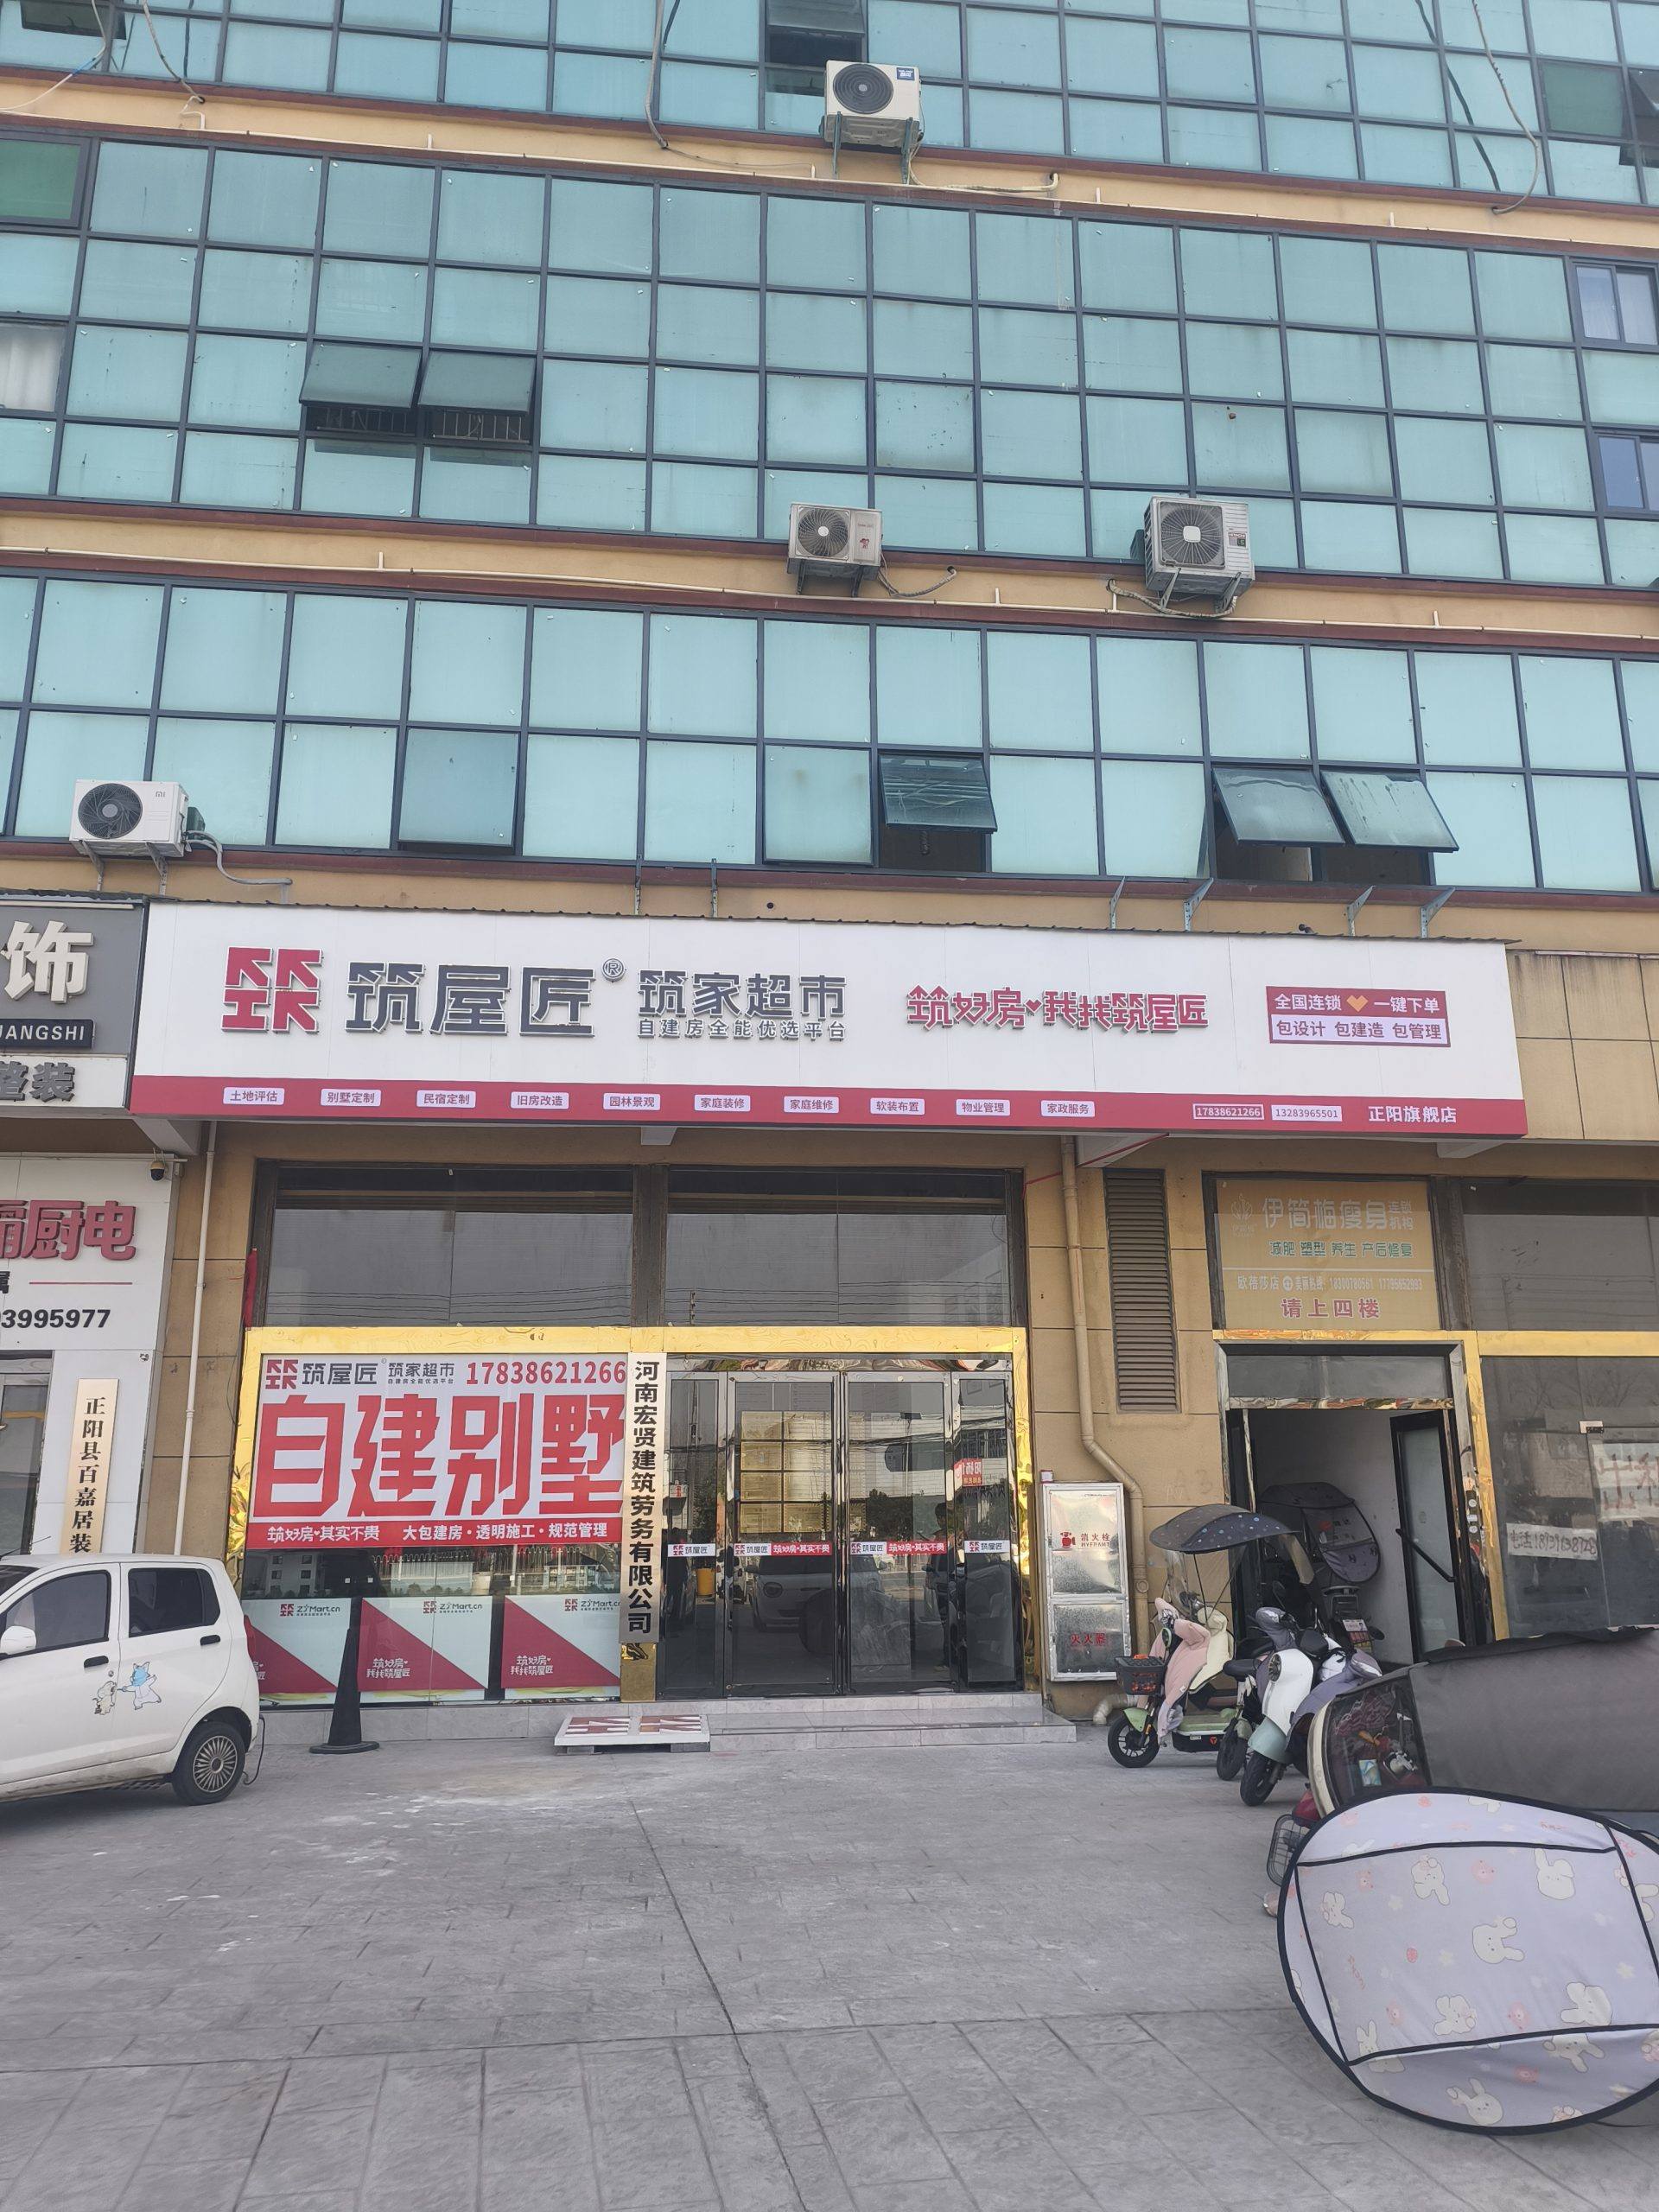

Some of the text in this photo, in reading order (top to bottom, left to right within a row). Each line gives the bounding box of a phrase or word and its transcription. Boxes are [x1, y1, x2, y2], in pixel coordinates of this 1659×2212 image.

[1, 920, 93, 1003] 饰
[346, 962, 594, 1036] 筑屋匠
[639, 970, 847, 1020] 筑家超市
[1274, 994, 1440, 1014] 全国连锁 一键下单
[0, 1025, 85, 1040] ANGSHI
[638, 1018, 847, 1040] 自建房全能优选平台
[1276, 1020, 1441, 1039] 包设计 包建造 包管理
[230, 1090, 1457, 1124] 土地评估 别墅定制 民宿定制 旧房改造 园林景观 家庭装修 家庭维修 软装布置 物业管理 家政服务 17838621266 13283965501 正阳旗舰店
[1269, 1241, 1413, 1258] 减肥 塑型 养生 产后修复
[0, 1308, 111, 1329] 3995977
[1281, 1297, 1380, 1319] 请上四楼
[302, 1363, 378, 1385] 筑屋匠
[388, 1363, 454, 1377] 筑家超市
[467, 1361, 626, 1385] 17838621266
[252, 1392, 626, 1518] 自建别墅
[69, 1397, 106, 1554] 正阳县百嘉居装
[628, 1360, 659, 1634] 河南宏贤建筑劳务有限公司
[1081, 1532, 1110, 1541] 消火栓
